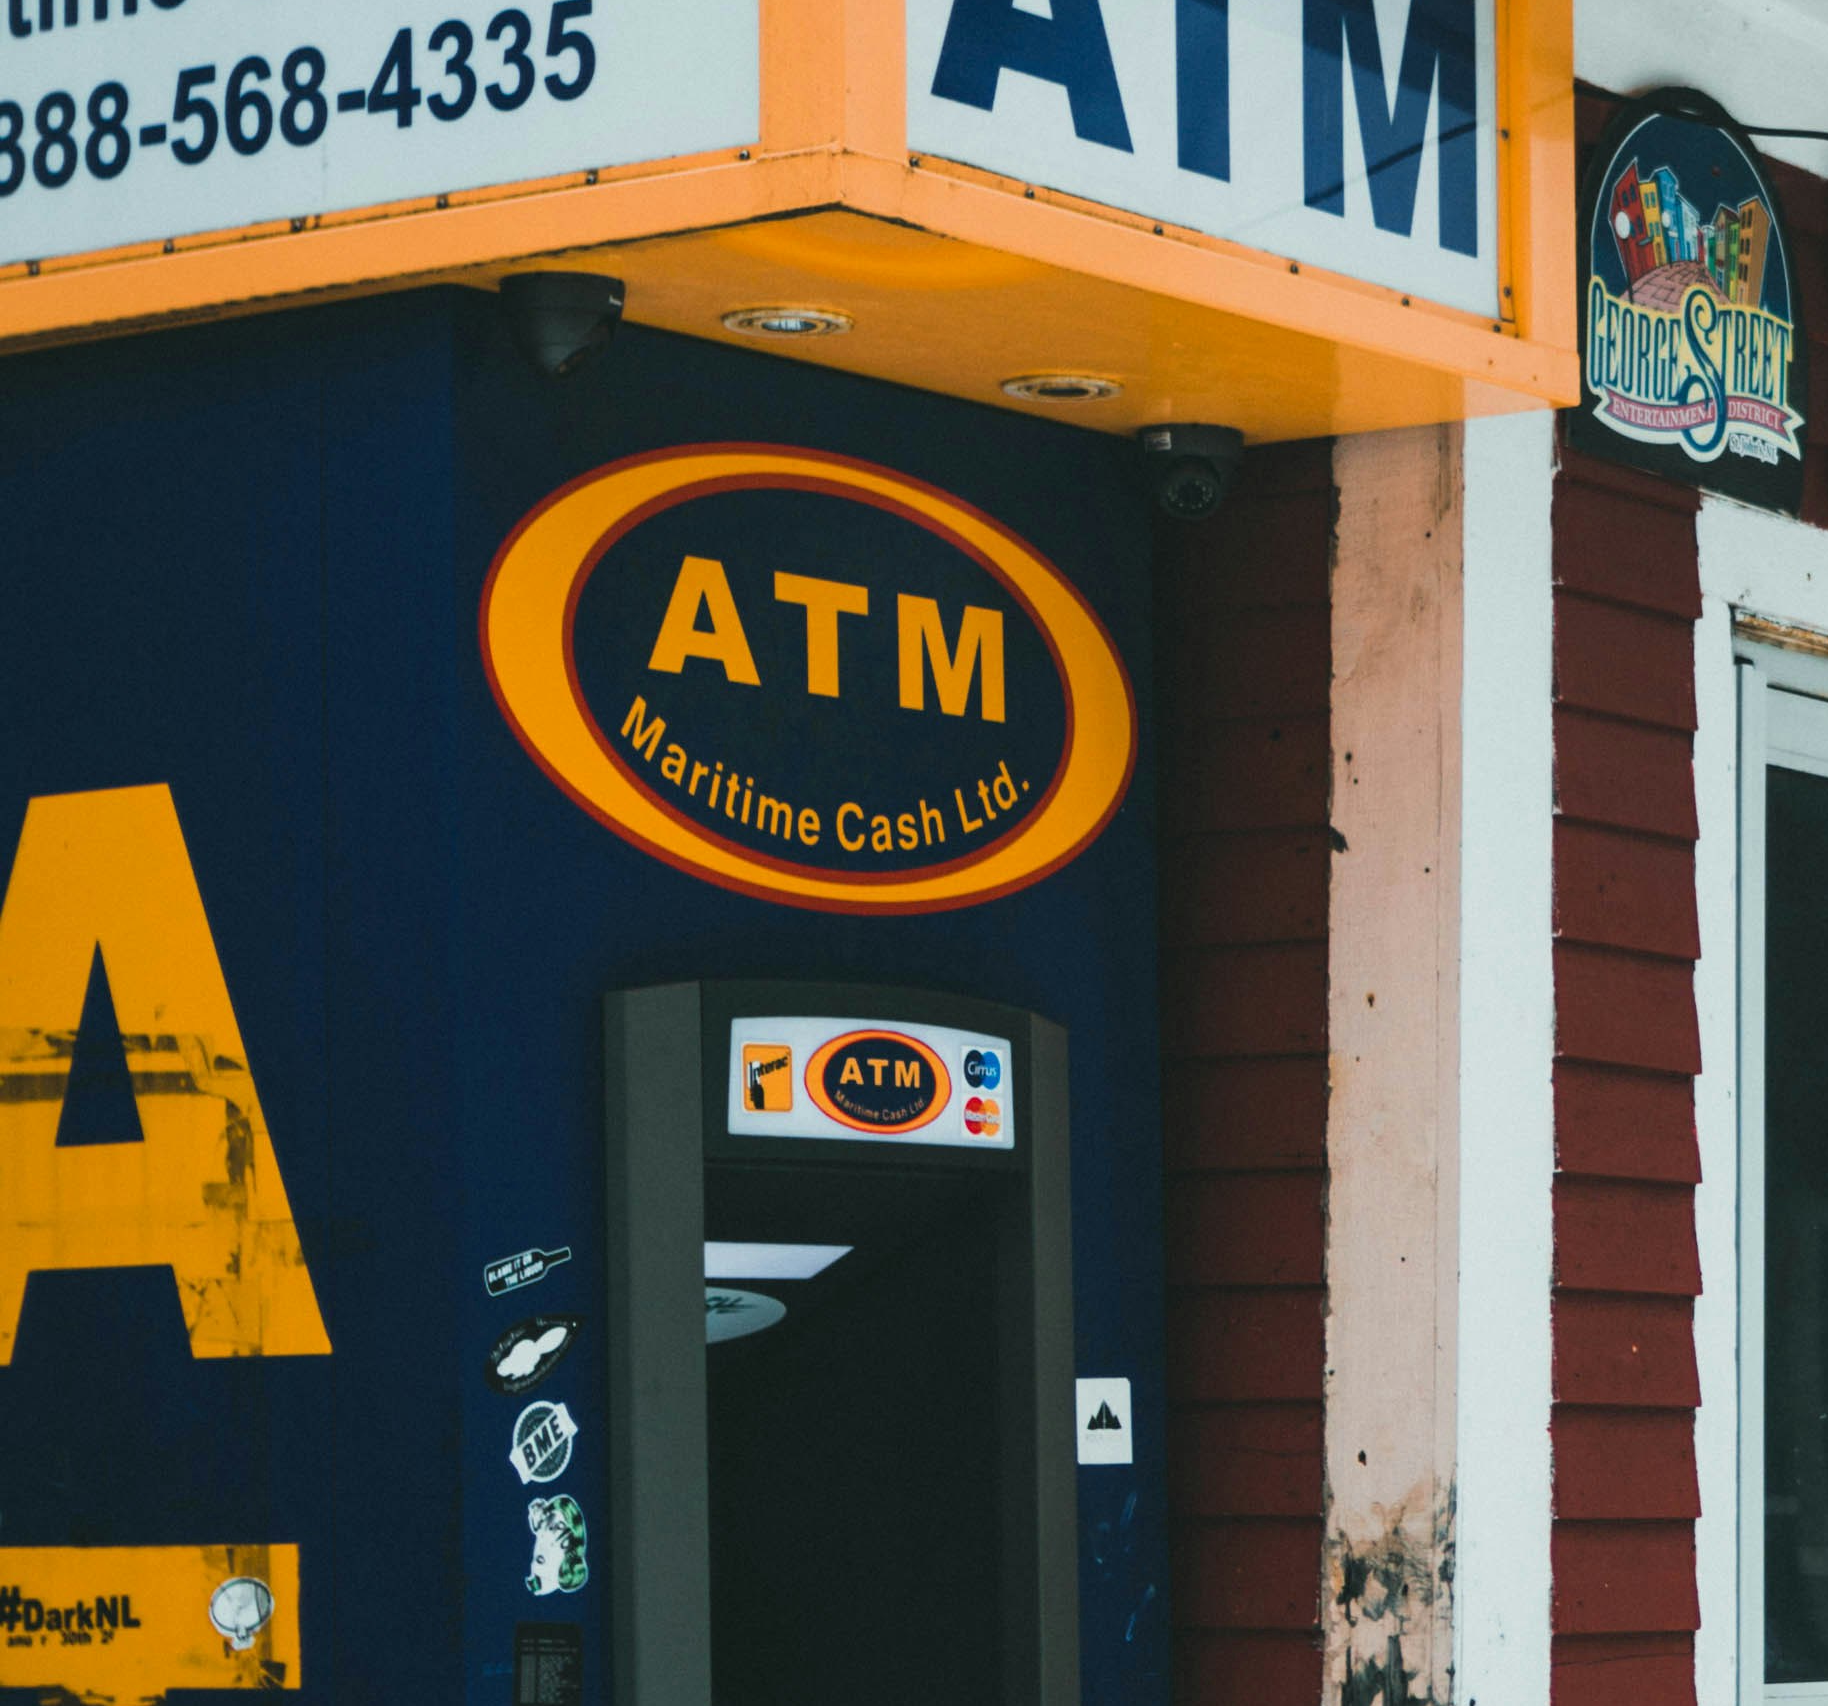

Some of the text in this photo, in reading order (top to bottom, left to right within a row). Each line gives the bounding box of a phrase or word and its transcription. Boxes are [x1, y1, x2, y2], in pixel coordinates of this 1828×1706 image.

[1588, 281, 1791, 454] GEORGE STREET
[1611, 400, 1783, 431] ENTERTAINMENT DISTRICT
[647, 554, 1006, 724] ATM
[619, 694, 1031, 853] Maritime Cash Ltd.
[839, 1056, 921, 1089] ATM
[966, 1060, 998, 1078] Cirrus
[834, 1090, 881, 1122] Maritime
[881, 1106, 908, 1122] Cash
[521, 1415, 565, 1470] BME
[0, 1585, 141, 1632] #DarkNL
